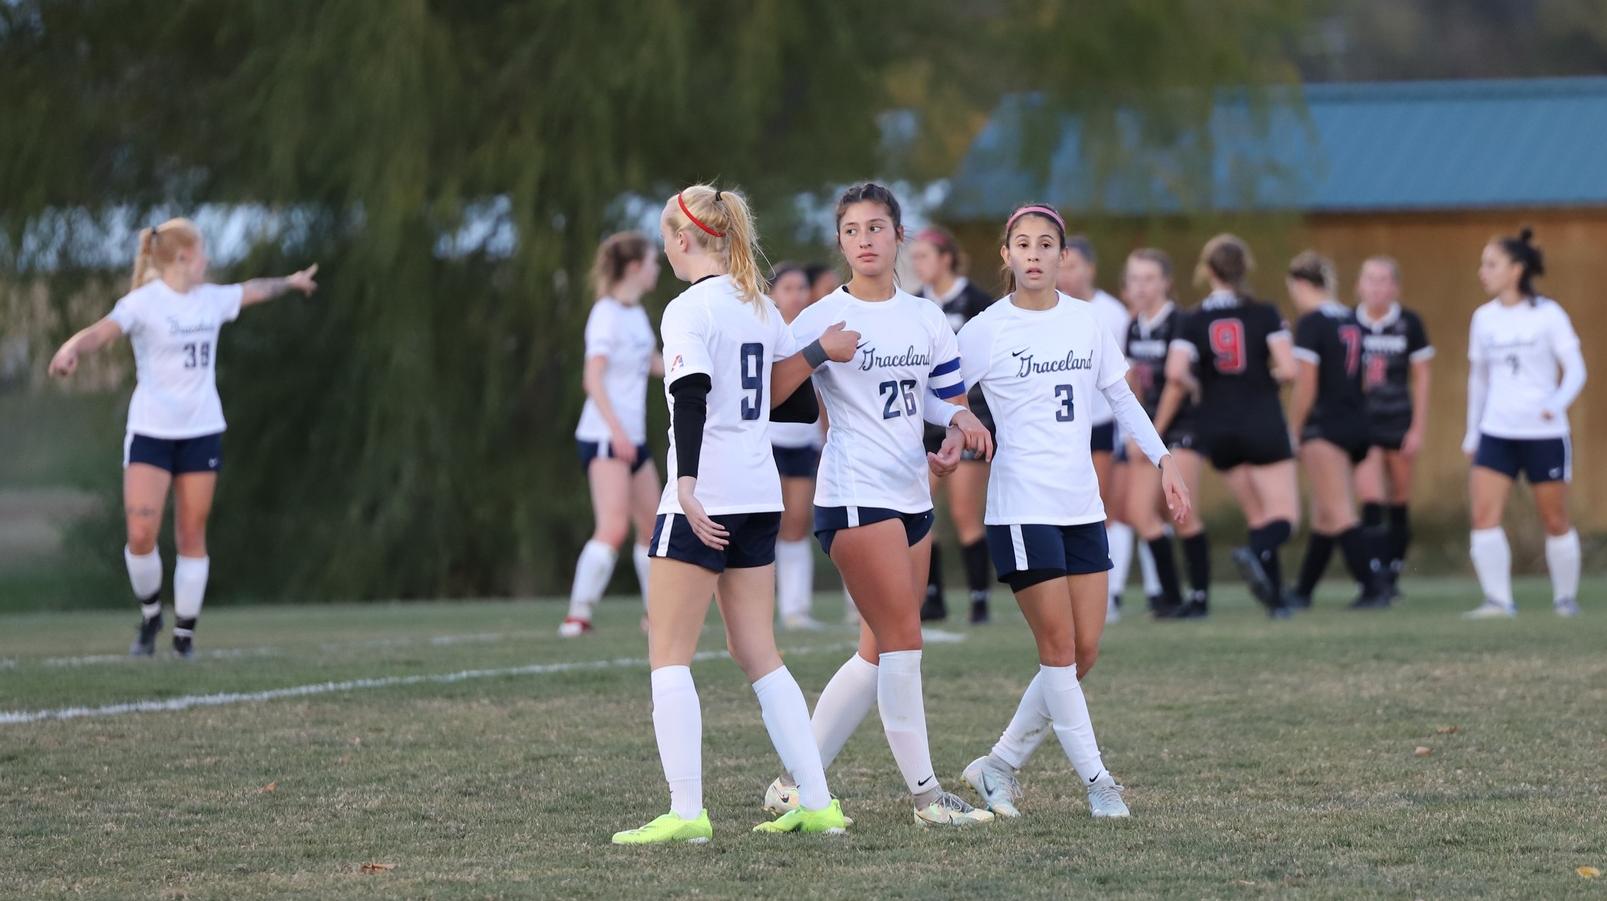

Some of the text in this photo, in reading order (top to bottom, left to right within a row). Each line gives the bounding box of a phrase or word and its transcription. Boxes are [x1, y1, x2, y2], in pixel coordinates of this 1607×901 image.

[858, 344, 930, 372] Graceland
[1015, 349, 1094, 378] Graceland
[1209, 318, 1247, 374] 9
[1338, 324, 1362, 378] 7
[740, 342, 764, 421] 9
[879, 379, 917, 420] 26
[1054, 383, 1075, 423] 3
